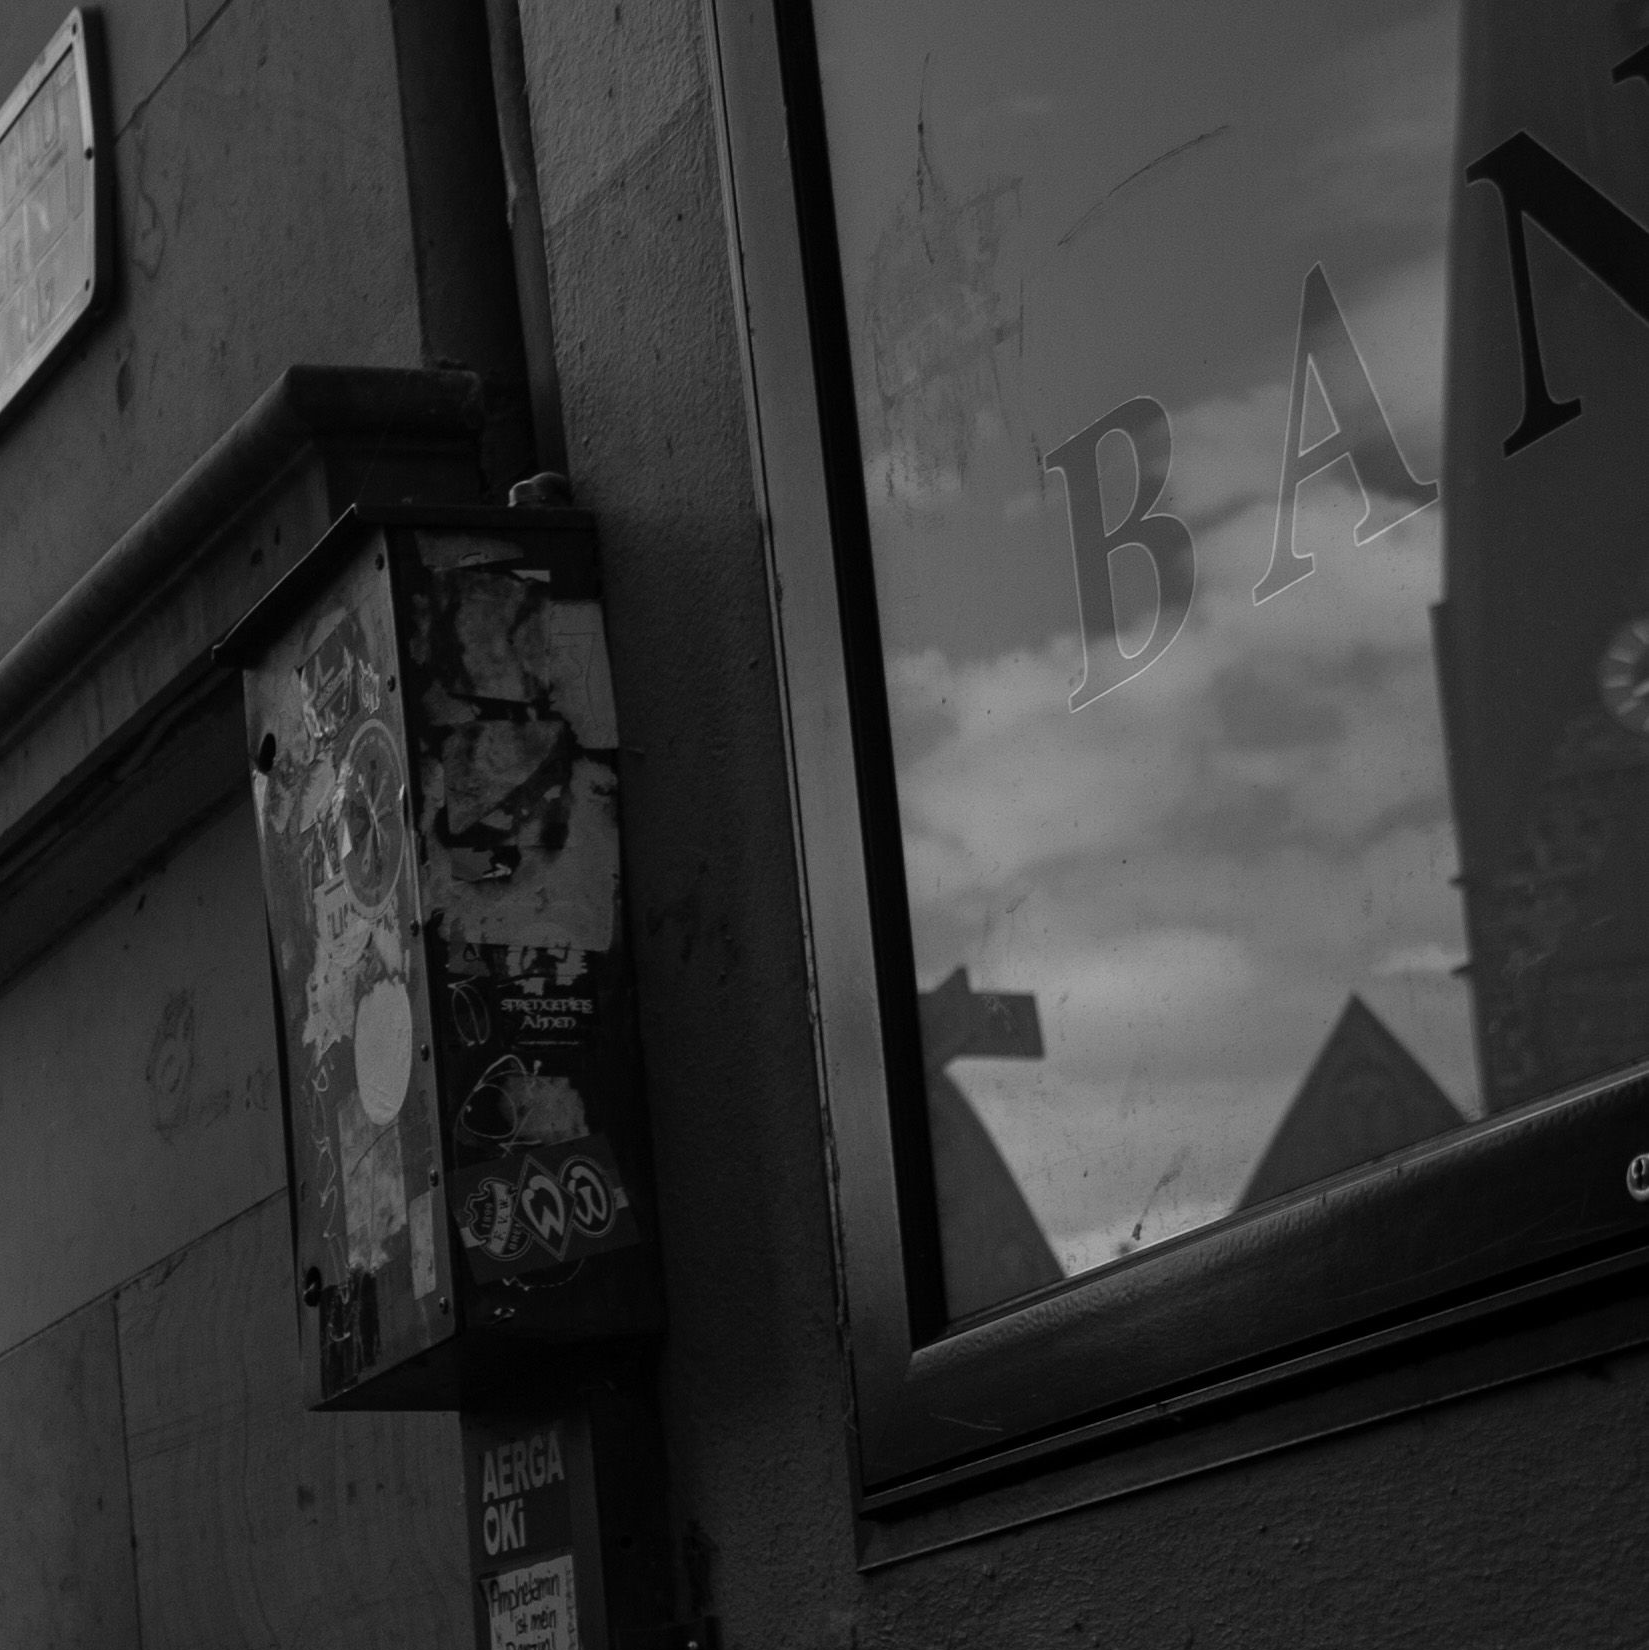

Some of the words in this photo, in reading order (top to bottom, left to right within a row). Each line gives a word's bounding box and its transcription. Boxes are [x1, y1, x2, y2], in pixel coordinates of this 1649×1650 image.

[482, 1430, 565, 1503] AERGA
[489, 1570, 560, 1621] Amphetamin
[514, 1613, 529, 1636] ist
[530, 1606, 557, 1631] mein
